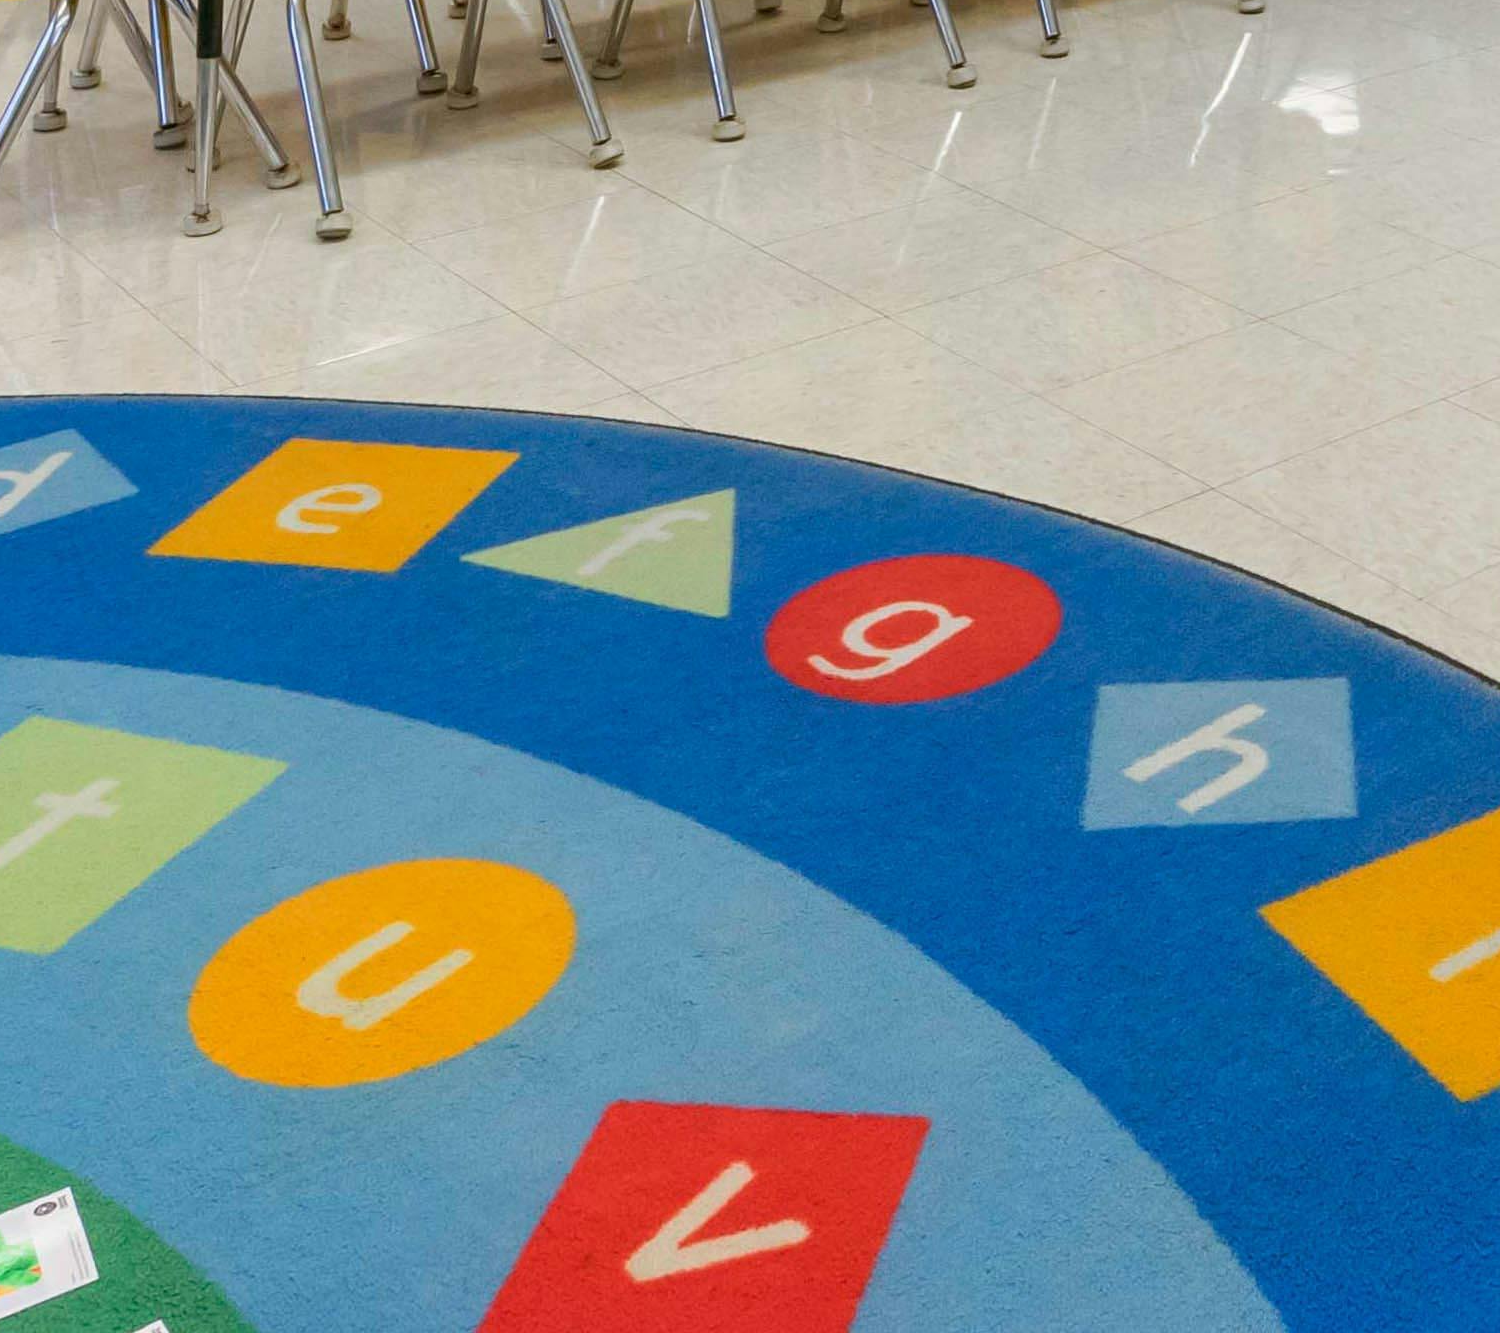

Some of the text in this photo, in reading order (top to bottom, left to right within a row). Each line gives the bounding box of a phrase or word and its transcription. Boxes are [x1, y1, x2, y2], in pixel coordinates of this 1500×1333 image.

[274, 483, 384, 534] e
[574, 505, 713, 577] f
[806, 599, 973, 681] g
[1122, 701, 1270, 815] h
[296, 920, 475, 1032] u
[622, 1160, 813, 1283] v
